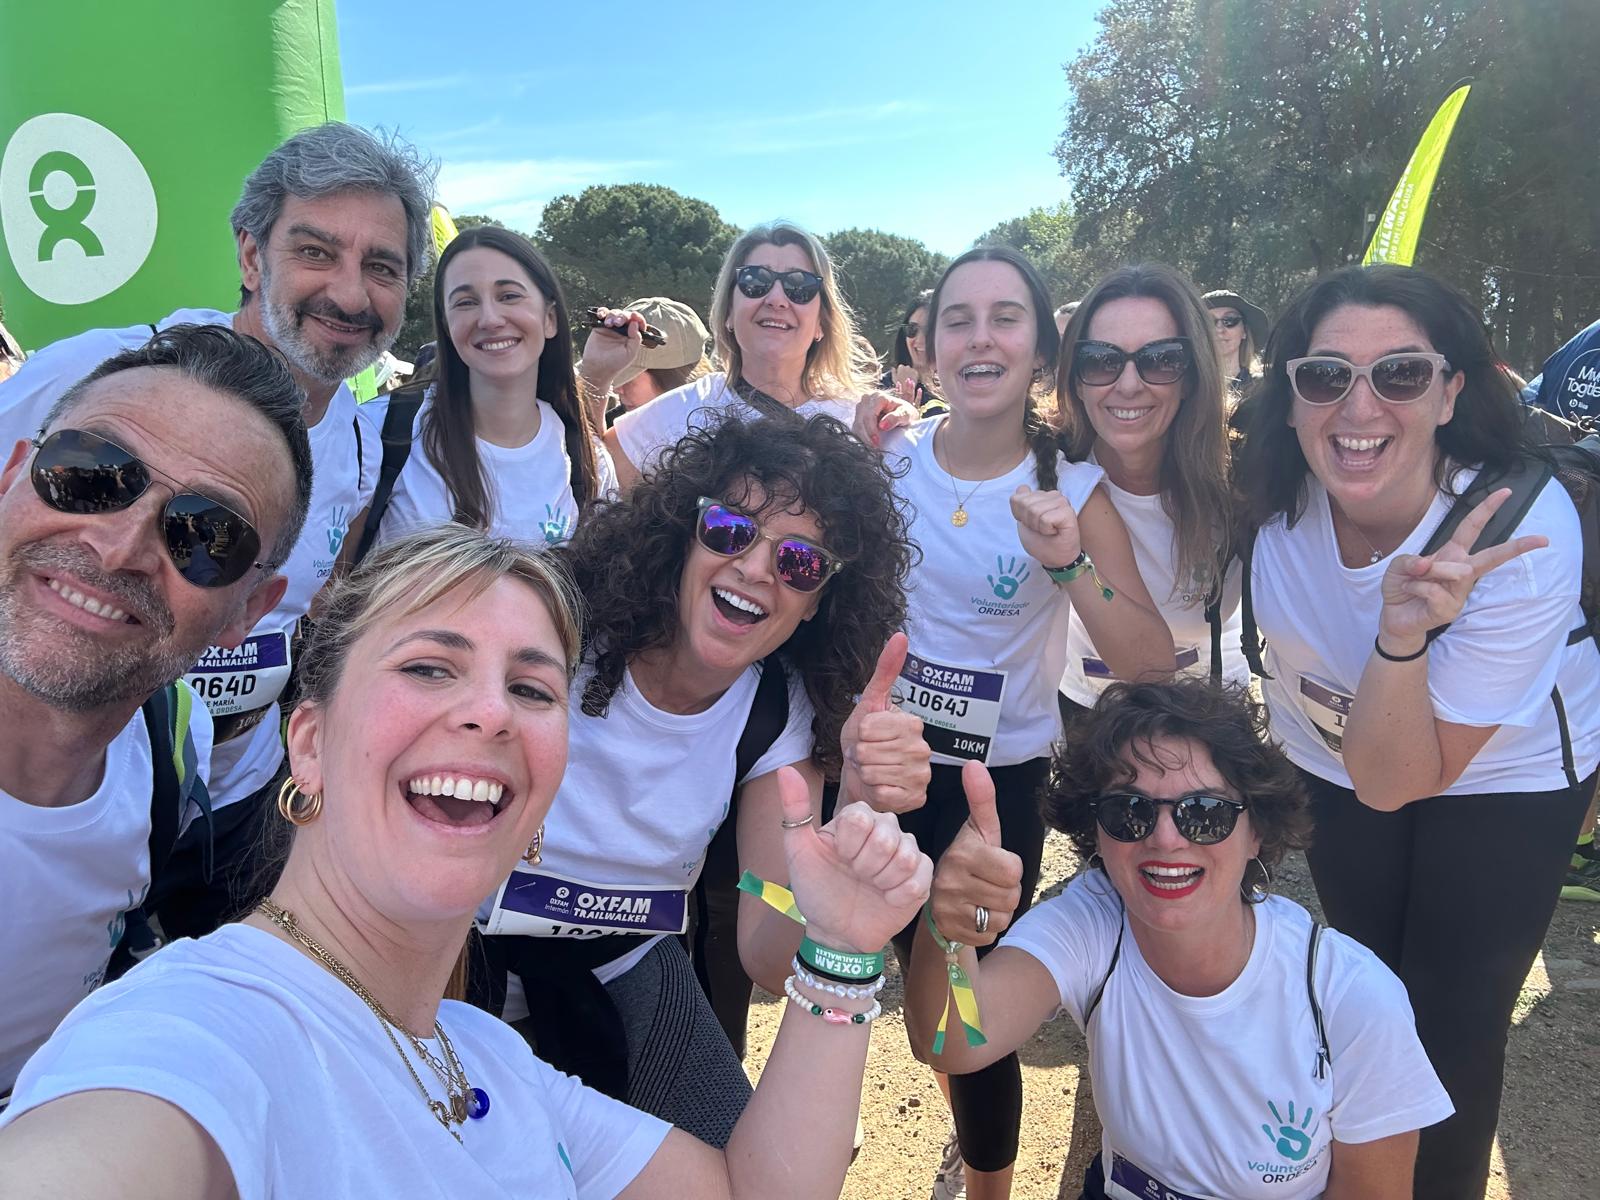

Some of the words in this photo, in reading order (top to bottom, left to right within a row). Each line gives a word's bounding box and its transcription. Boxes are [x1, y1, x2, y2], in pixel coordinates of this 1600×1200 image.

[978, 606, 1020, 616] ORDESA
[197, 656, 258, 667] RAILWALKER
[923, 666, 975, 686] OXFAM
[192, 674, 257, 699] 064D
[921, 676, 973, 693] TRAILWALKER
[216, 705, 242, 714] ORDESA
[906, 686, 969, 718] 1064J
[953, 738, 985, 754] 10KM
[549, 897, 569, 907] OXFAM
[577, 893, 652, 914] OXFAM
[573, 907, 648, 923] TRAILWALKER
[815, 953, 862, 975] OXFAM
